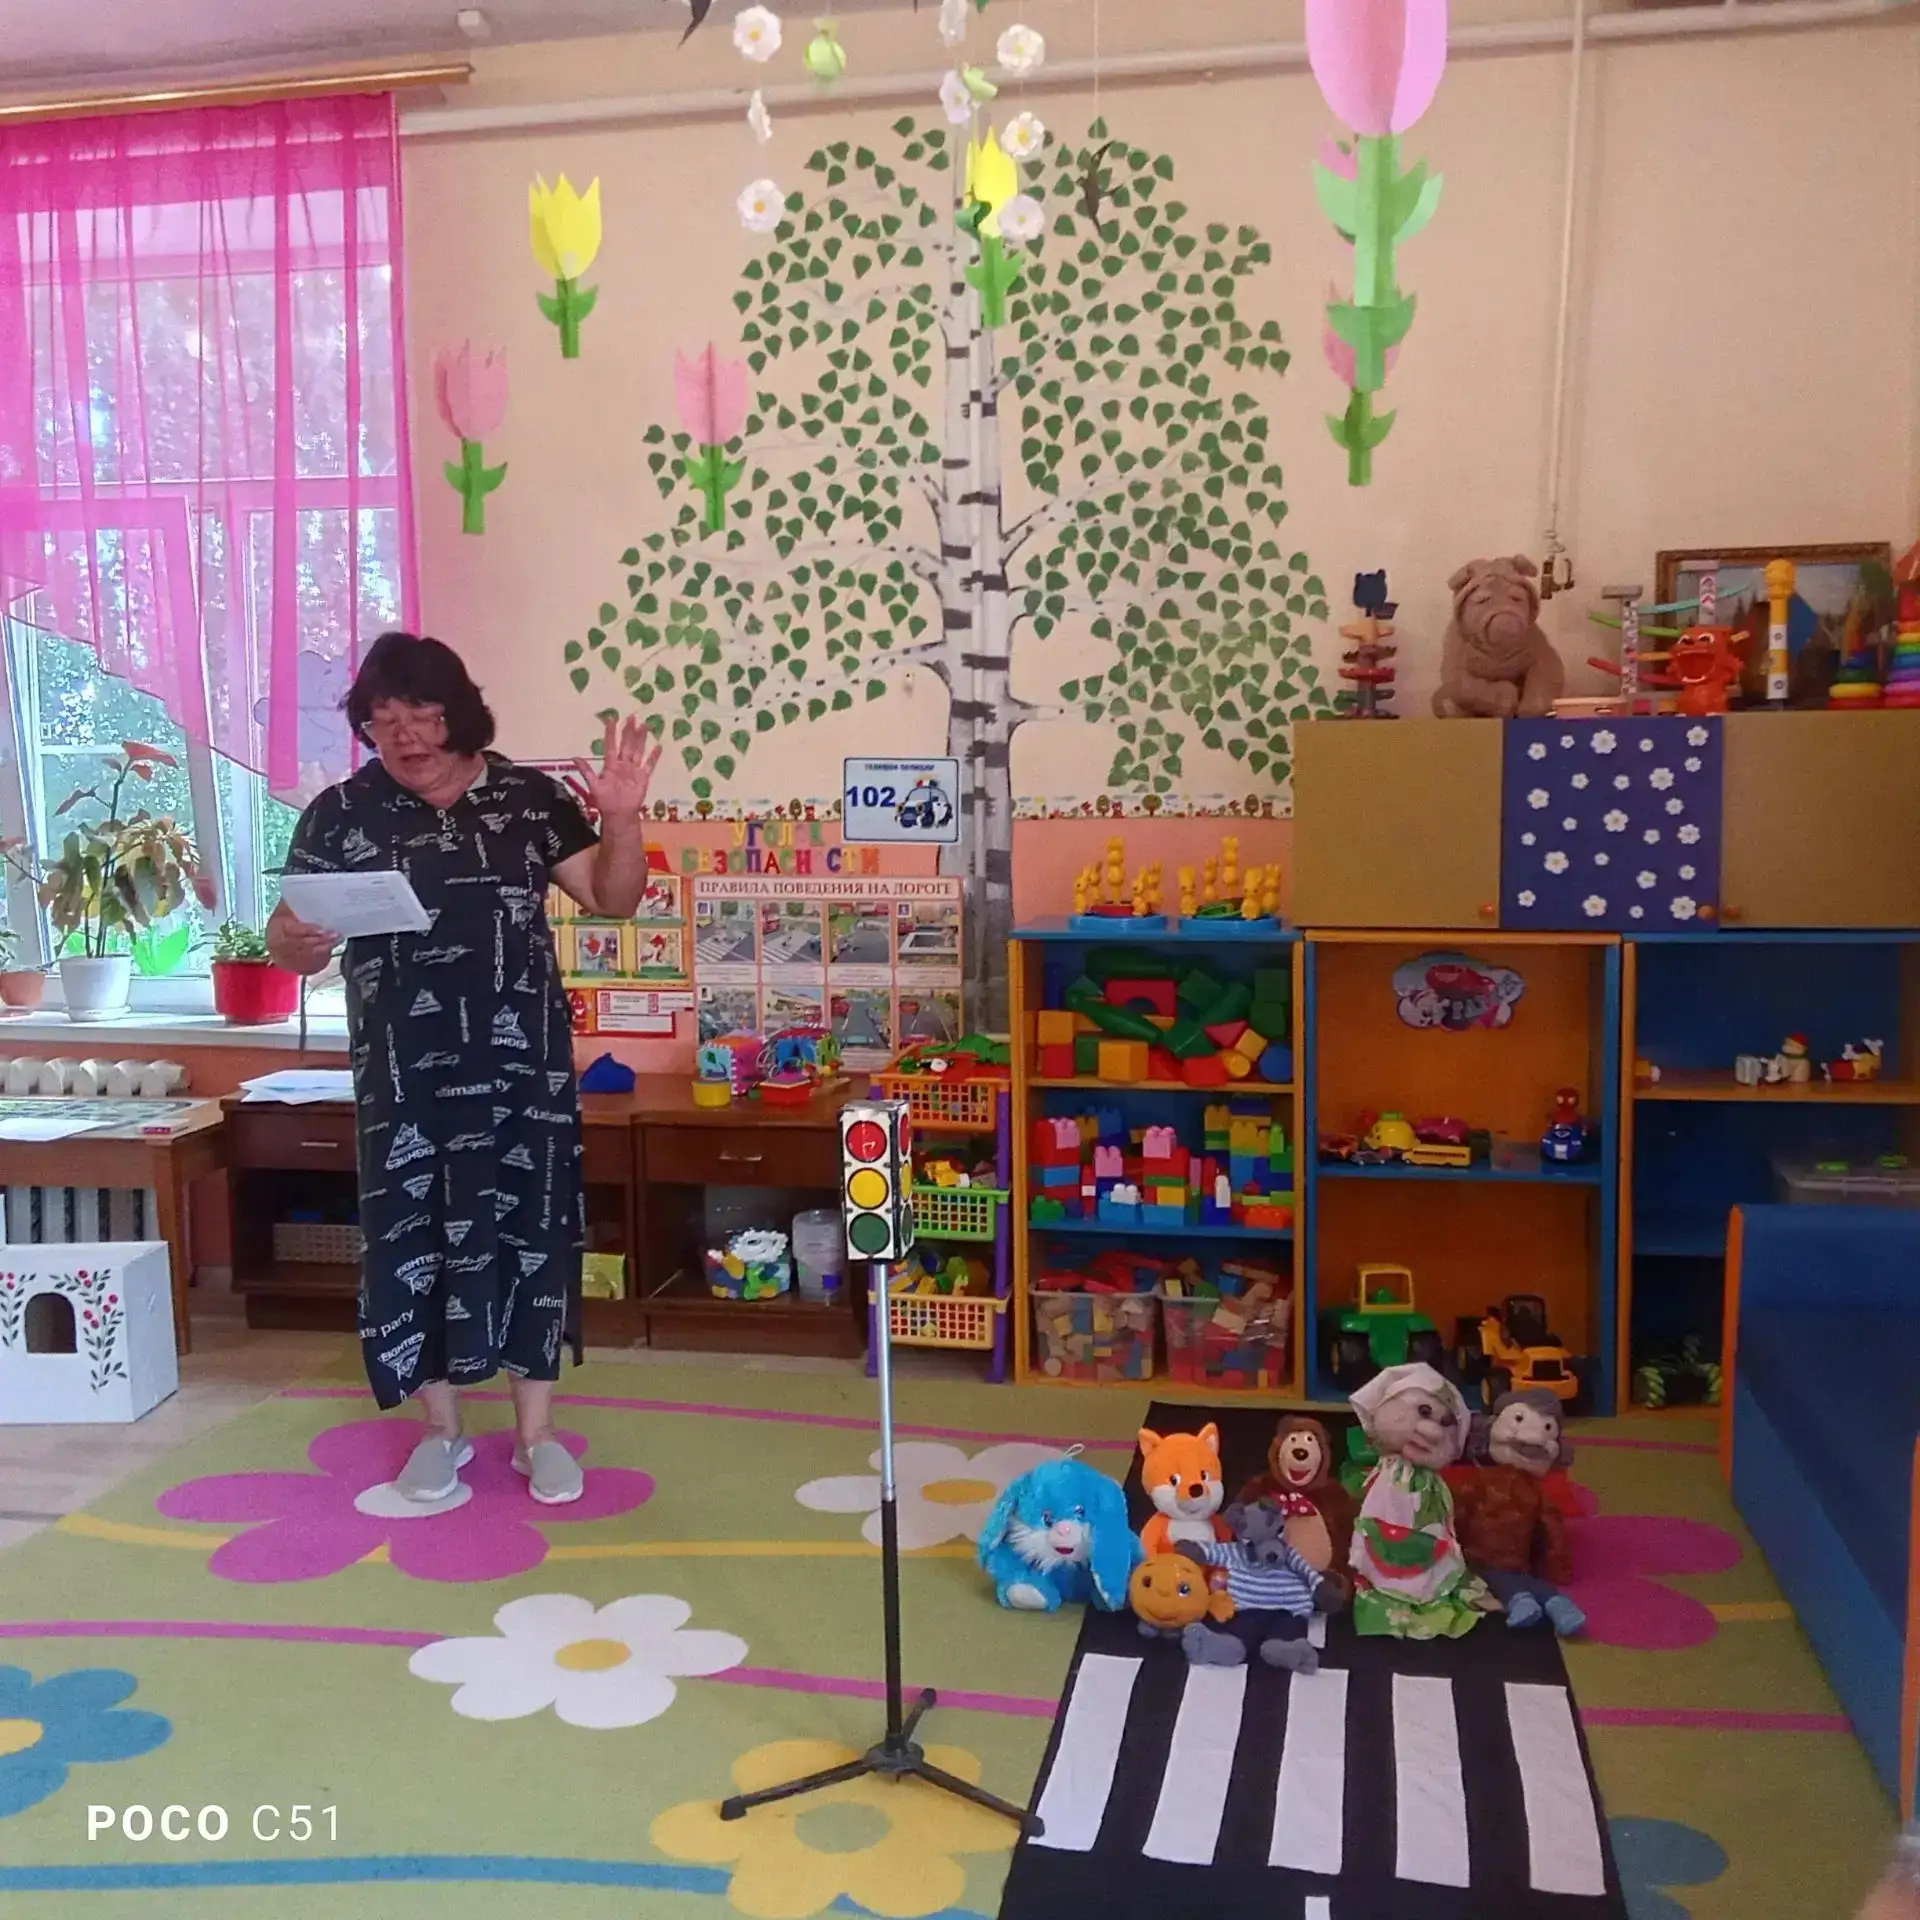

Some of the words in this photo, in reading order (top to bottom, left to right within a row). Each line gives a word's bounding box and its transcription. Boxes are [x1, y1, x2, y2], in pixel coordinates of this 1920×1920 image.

[846, 786, 896, 807] 102
[731, 821, 824, 847] УГОЛК
[681, 848, 880, 875] БЕЗОПАСНСТИ
[700, 881, 770, 894] ПРАВИЛА
[774, 881, 865, 895] ПОВЕДЕНИЯ
[870, 882, 890, 895] НА
[893, 882, 951, 895] ДОРОГЕ
[381, 1309, 414, 1338] party
